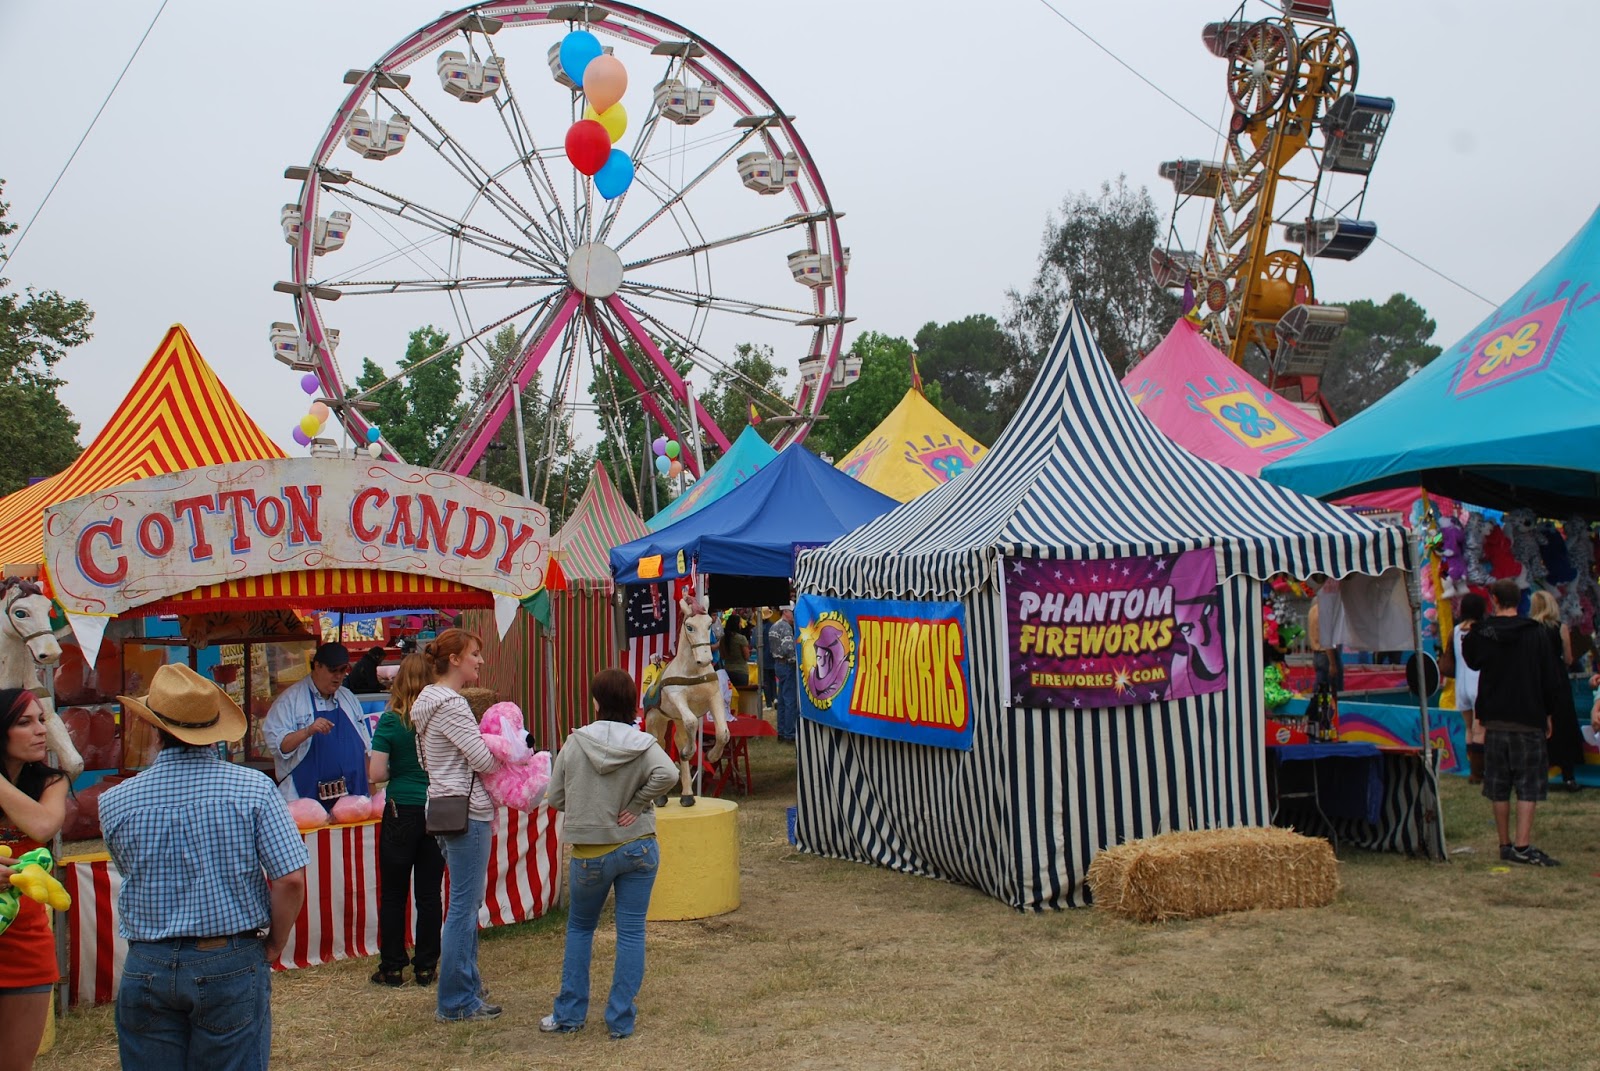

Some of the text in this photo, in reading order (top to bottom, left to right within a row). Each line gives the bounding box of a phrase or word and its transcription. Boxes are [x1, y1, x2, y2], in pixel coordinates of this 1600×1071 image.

[76, 485, 534, 588] COTTON CANDY
[1019, 585, 1173, 622] PHANTOM
[819, 611, 855, 668] PHANTOM
[1019, 618, 1174, 657] FIREWORKS
[851, 620, 965, 728] FIREWORKS
[1031, 667, 1165, 686] FIREWORKS COM
